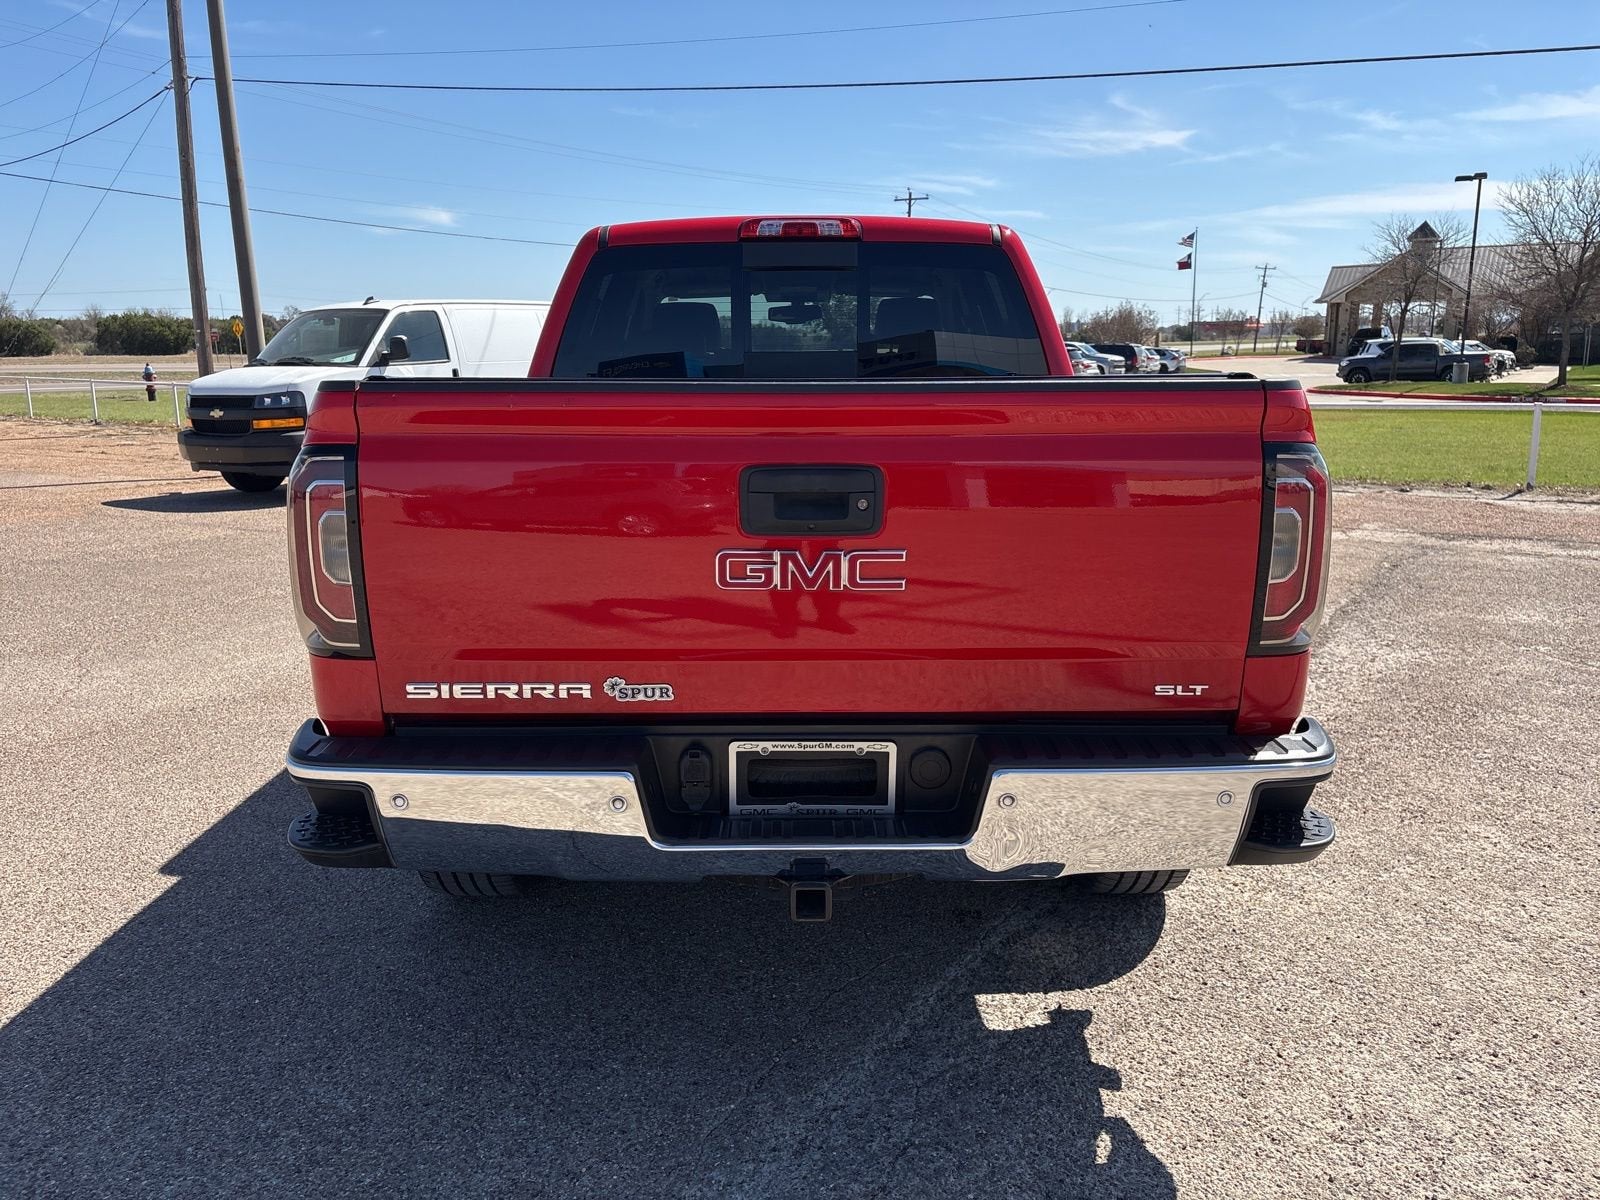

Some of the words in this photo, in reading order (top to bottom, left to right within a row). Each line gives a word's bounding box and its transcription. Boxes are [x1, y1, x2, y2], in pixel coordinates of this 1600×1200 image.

[716, 550, 907, 591] GMC
[405, 682, 592, 699] SIERRA
[617, 687, 672, 698] SPUR
[1154, 685, 1209, 696] SLT
[771, 742, 855, 750] www.SpurGM.com
[740, 808, 778, 816] GMC
[846, 808, 885, 816] GMC
